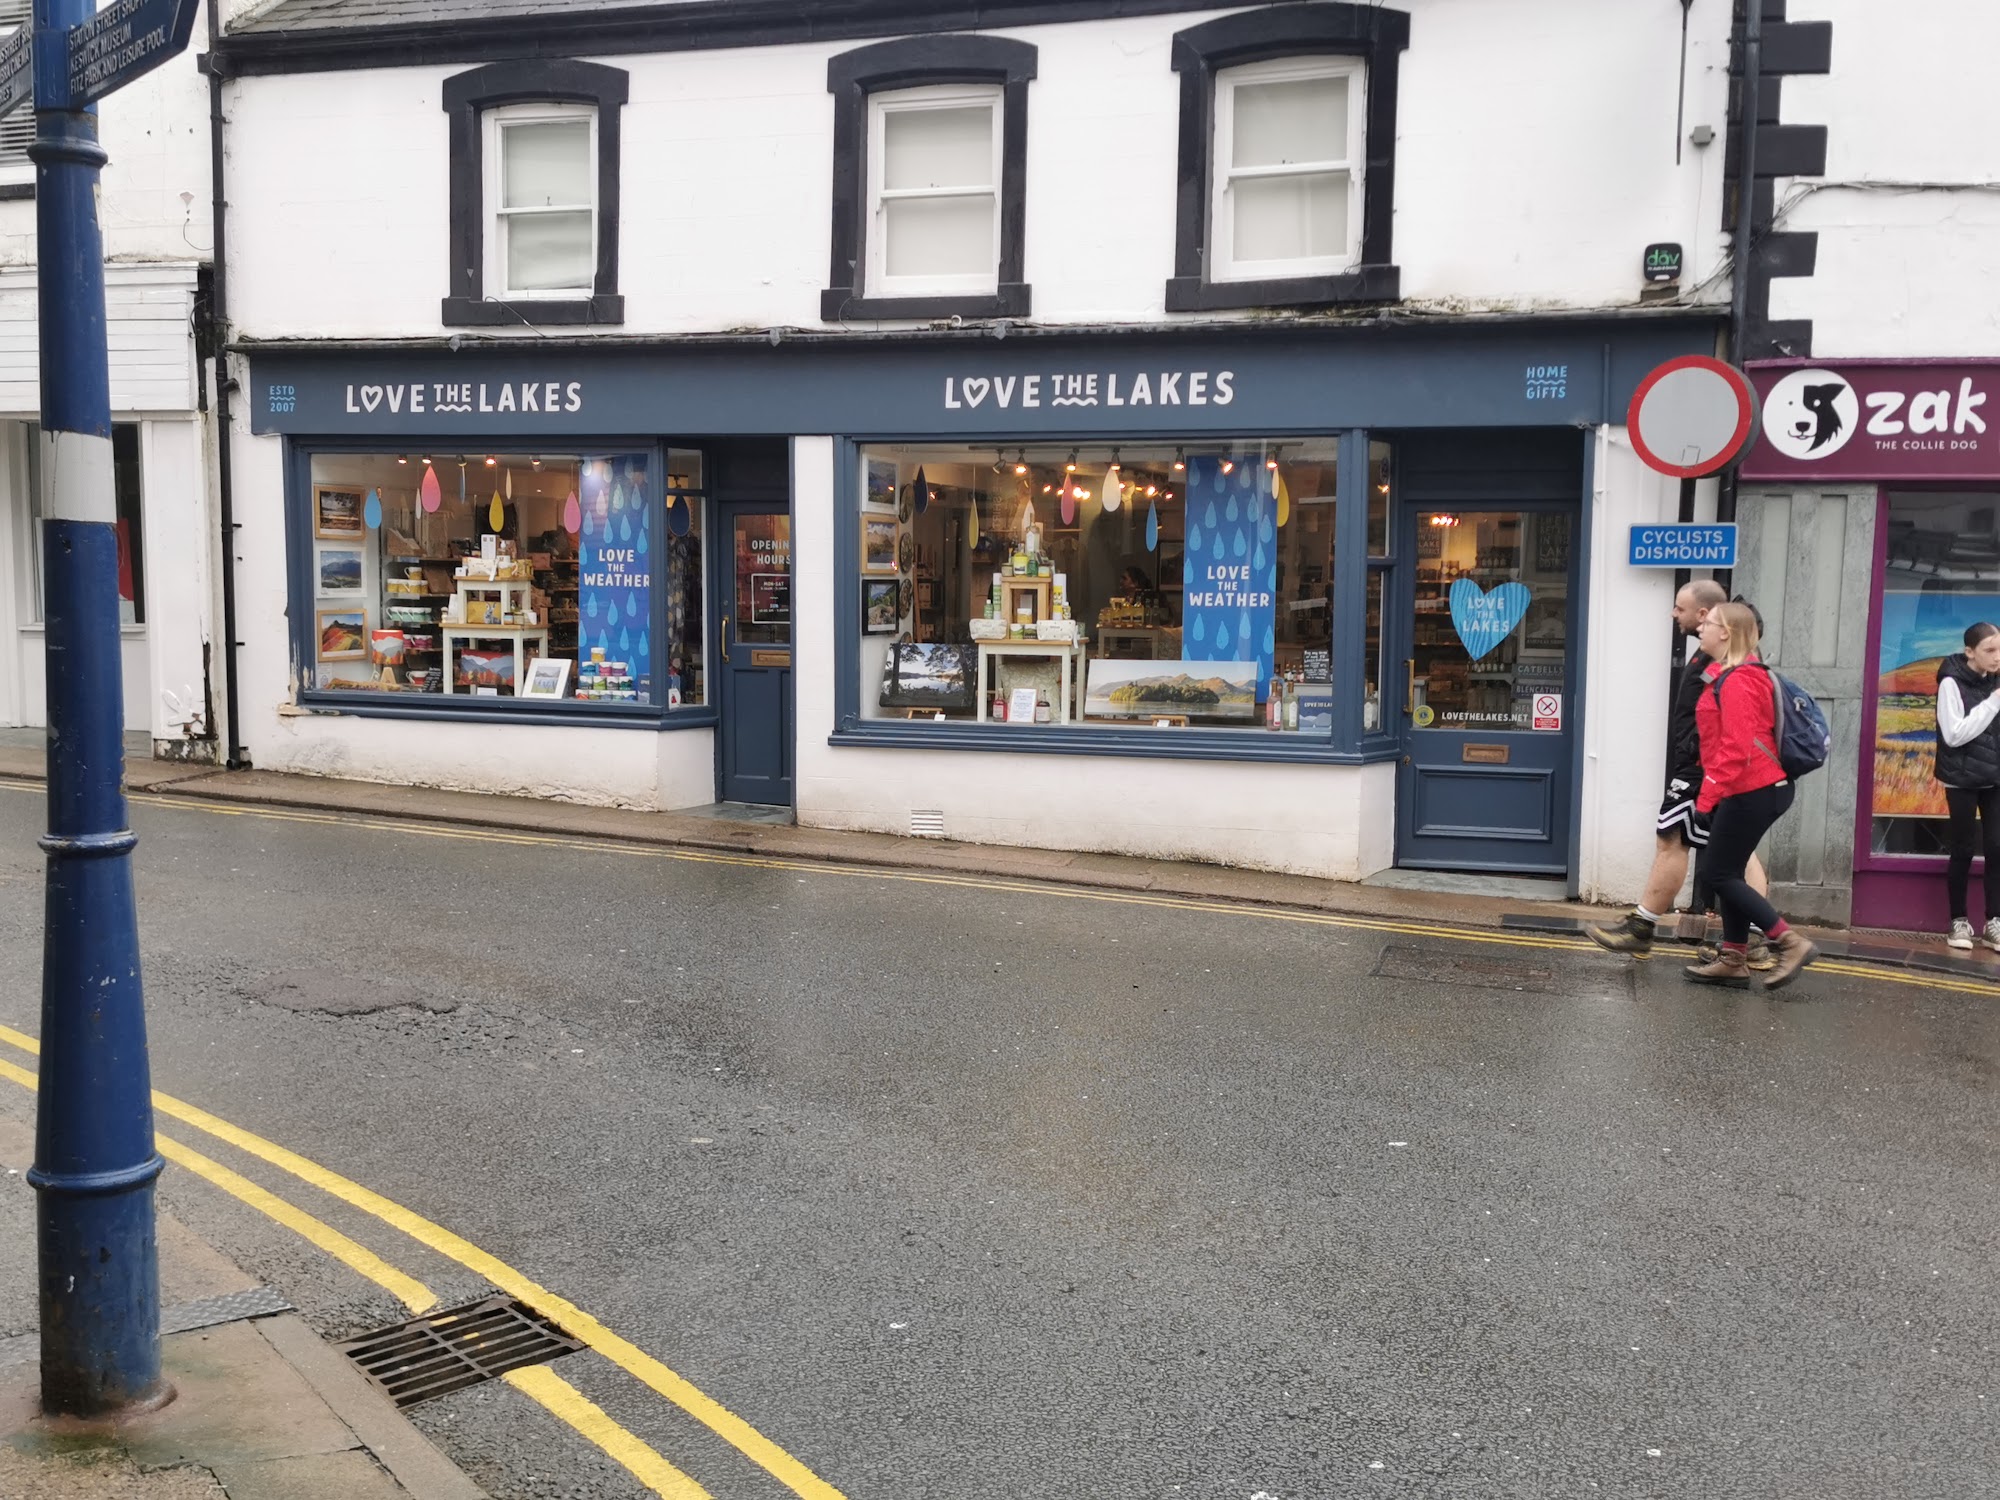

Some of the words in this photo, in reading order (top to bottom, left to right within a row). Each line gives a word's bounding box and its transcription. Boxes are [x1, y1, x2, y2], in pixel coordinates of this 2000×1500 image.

[69, 20, 95, 51] STATION
[96, 4, 122, 34] STREET
[70, 43, 101, 74] KESWICK
[101, 21, 132, 57] MUSEUM
[70, 74, 85, 96] FITZ
[84, 63, 103, 88] PARK
[101, 54, 117, 77] AND
[118, 37, 146, 69] LEISURE
[146, 24, 166, 52] POOL
[1526, 365, 1568, 378] HOME
[269, 385, 295, 396] ESTD
[945, 375, 1041, 409] LOVE
[1052, 373, 1098, 396] THE
[1107, 371, 1235, 406] LAKES
[1526, 385, 1566, 399] GIFTS
[346, 384, 425, 413] LOVE
[434, 384, 472, 403] THE
[479, 382, 582, 413] LAKES
[269, 402, 295, 413] 2007
[1865, 377, 1987, 436] zak
[1875, 440, 1897, 450] THE
[1902, 440, 1945, 450] COLLIE
[1950, 440, 1978, 450] DOG
[1642, 530, 1723, 544] CYCLISTS
[751, 540, 790, 550] OPENIN
[598, 549, 635, 563] LOVE
[757, 554, 790, 565] HOURS
[1635, 546, 1729, 559] DISMOUNT
[607, 563, 625, 573] THE
[1207, 565, 1250, 580] LOVE
[584, 573, 650, 587] WEATHER
[1217, 581, 1238, 591] THE
[1189, 592, 1270, 608] WEATHER
[1467, 596, 1505, 610] LOVE
[1477, 610, 1495, 619] THE
[1463, 619, 1510, 632] LAKES
[1441, 711, 1529, 723] LOVETHELAKES.NET
